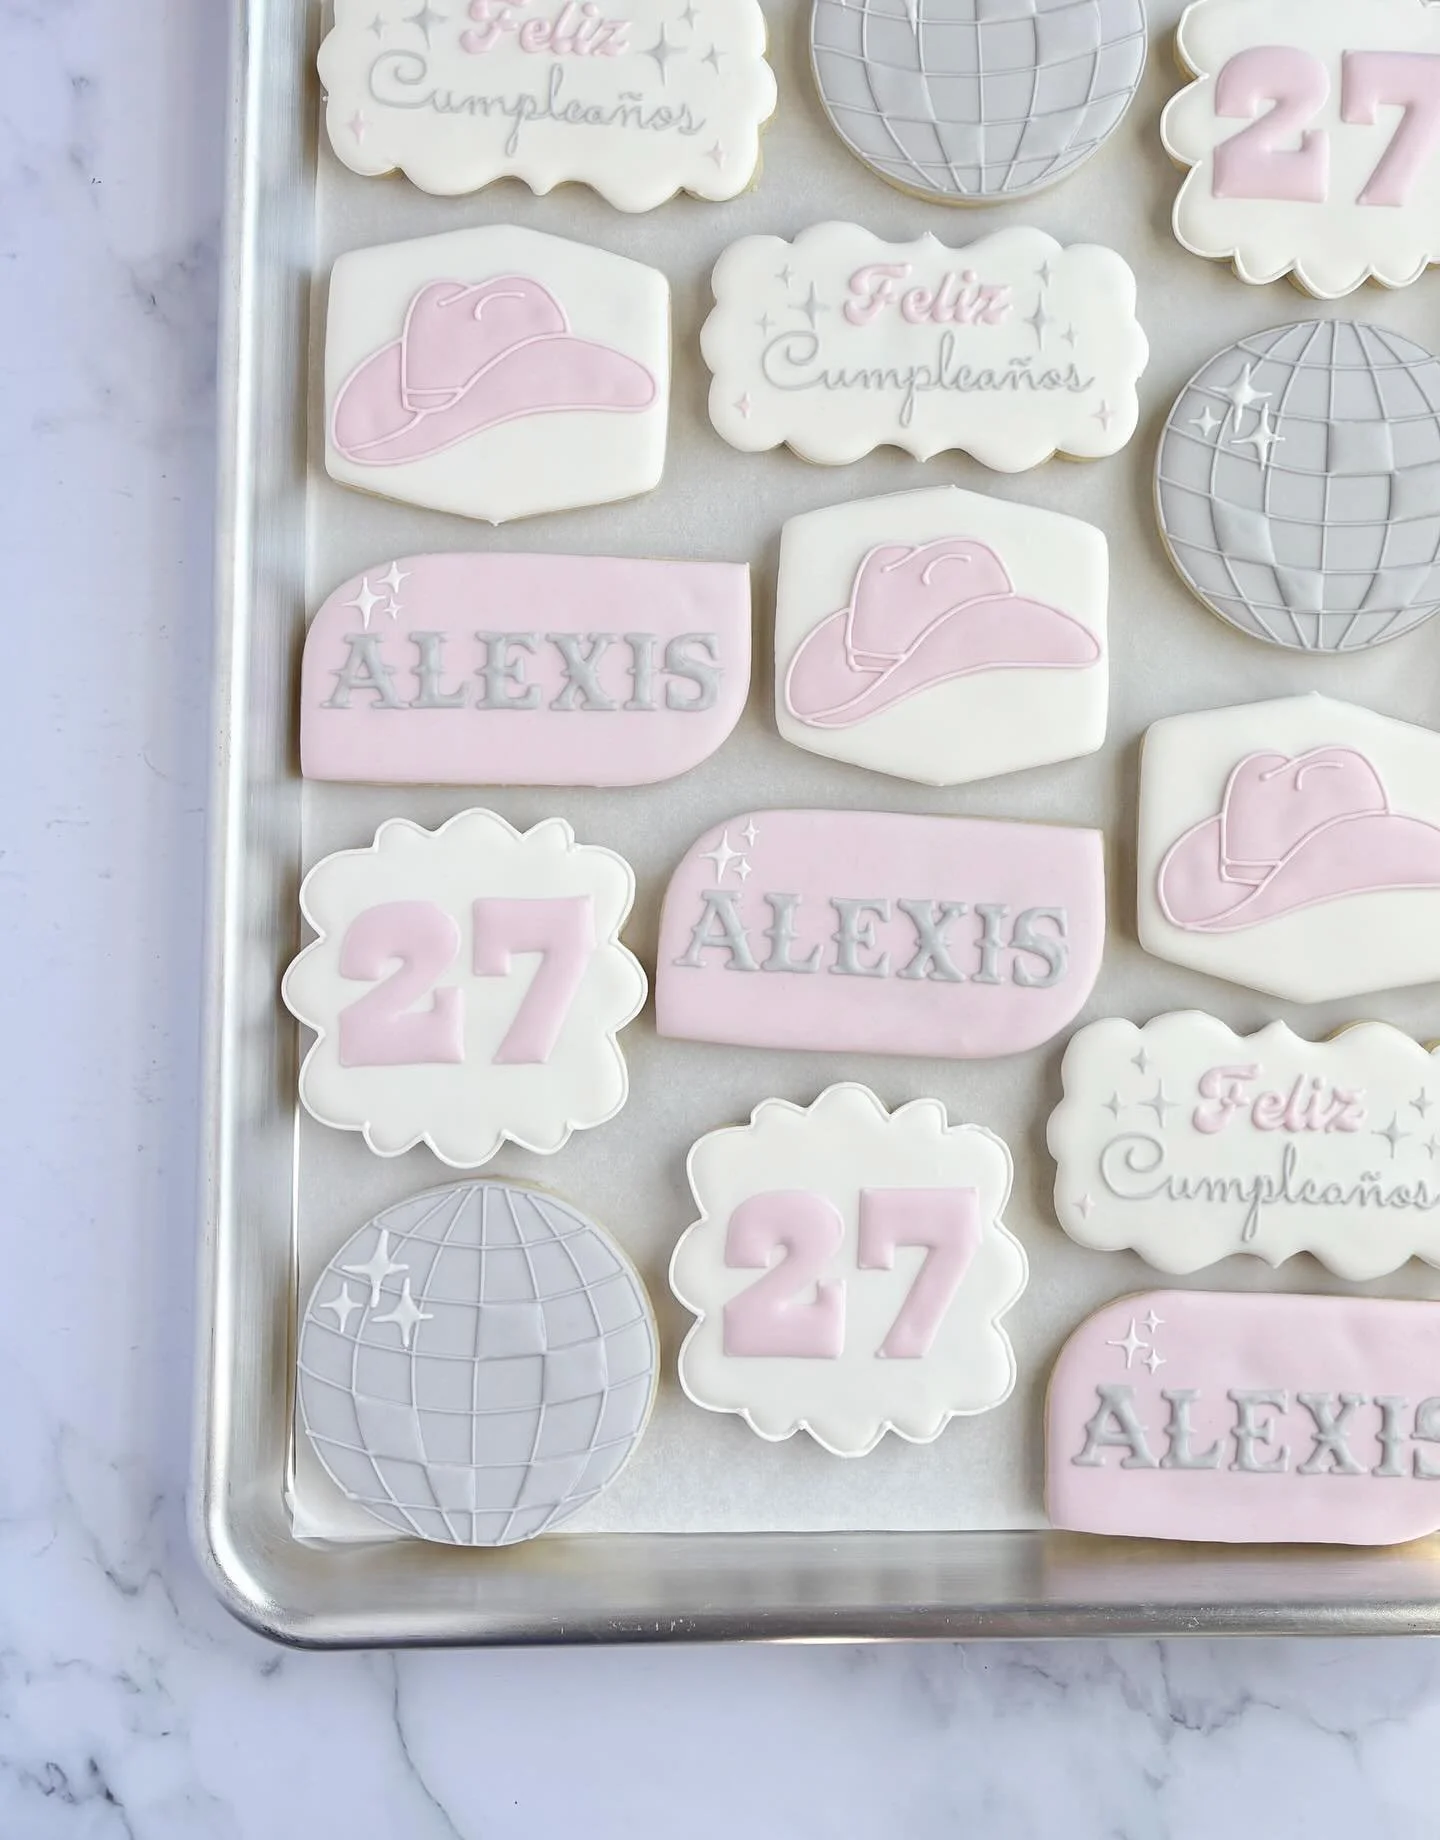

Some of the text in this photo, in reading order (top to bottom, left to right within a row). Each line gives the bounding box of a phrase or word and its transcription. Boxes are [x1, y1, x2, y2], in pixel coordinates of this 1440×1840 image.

[459, 0, 633, 56] Feliz
[369, 49, 706, 158] Cumpleaños
[1212, 45, 1440, 207] 27
[843, 262, 1013, 327] Feliz
[761, 330, 1095, 428] Cumpleaños
[320, 631, 726, 712] ALEXIS
[338, 895, 599, 1068] 27
[673, 889, 1070, 988] ALEXIS
[1192, 1063, 1368, 1134] Feliz
[1100, 1132, 1440, 1242] Cumpleaños
[723, 1187, 983, 1359] 27
